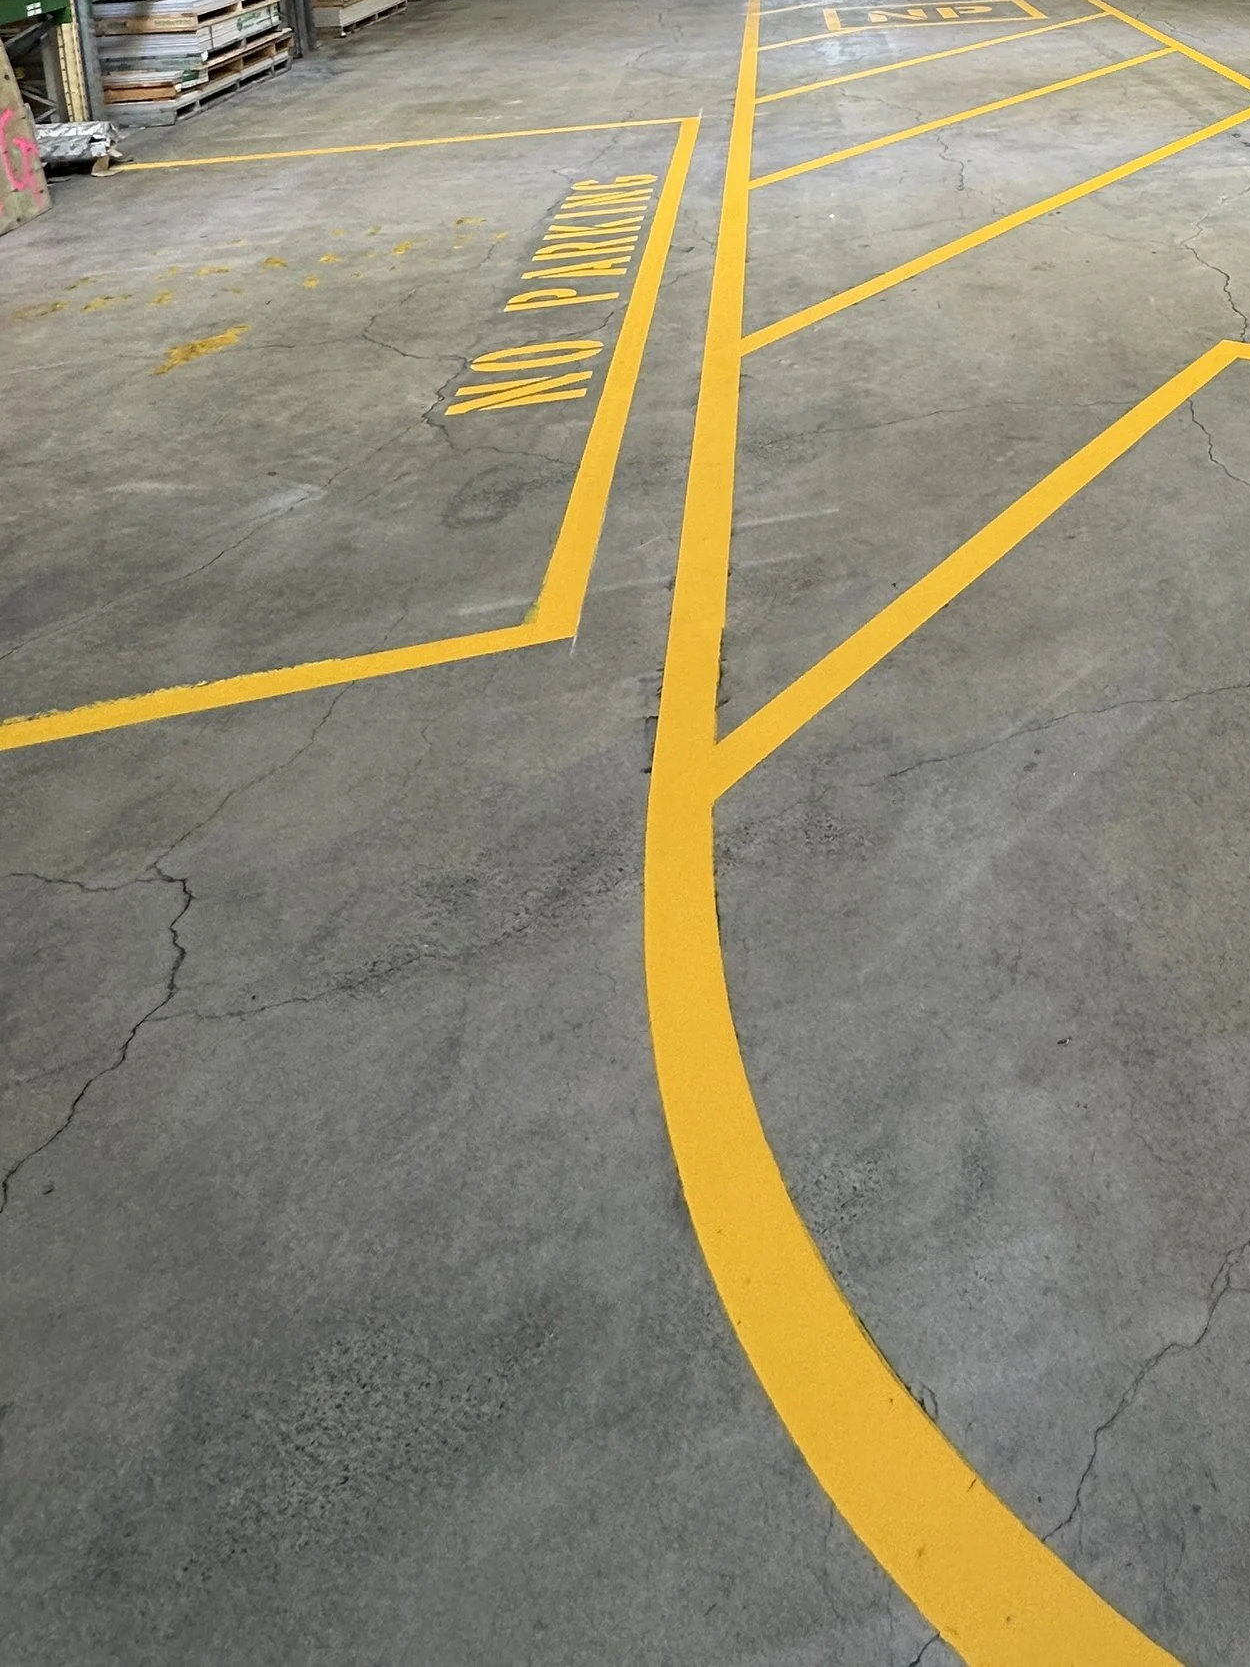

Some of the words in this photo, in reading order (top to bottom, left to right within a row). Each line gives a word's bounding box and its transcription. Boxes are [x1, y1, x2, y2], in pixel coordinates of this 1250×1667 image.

[868, 5, 992, 23] NP
[503, 173, 658, 312] PARKING
[444, 340, 604, 416] NO
